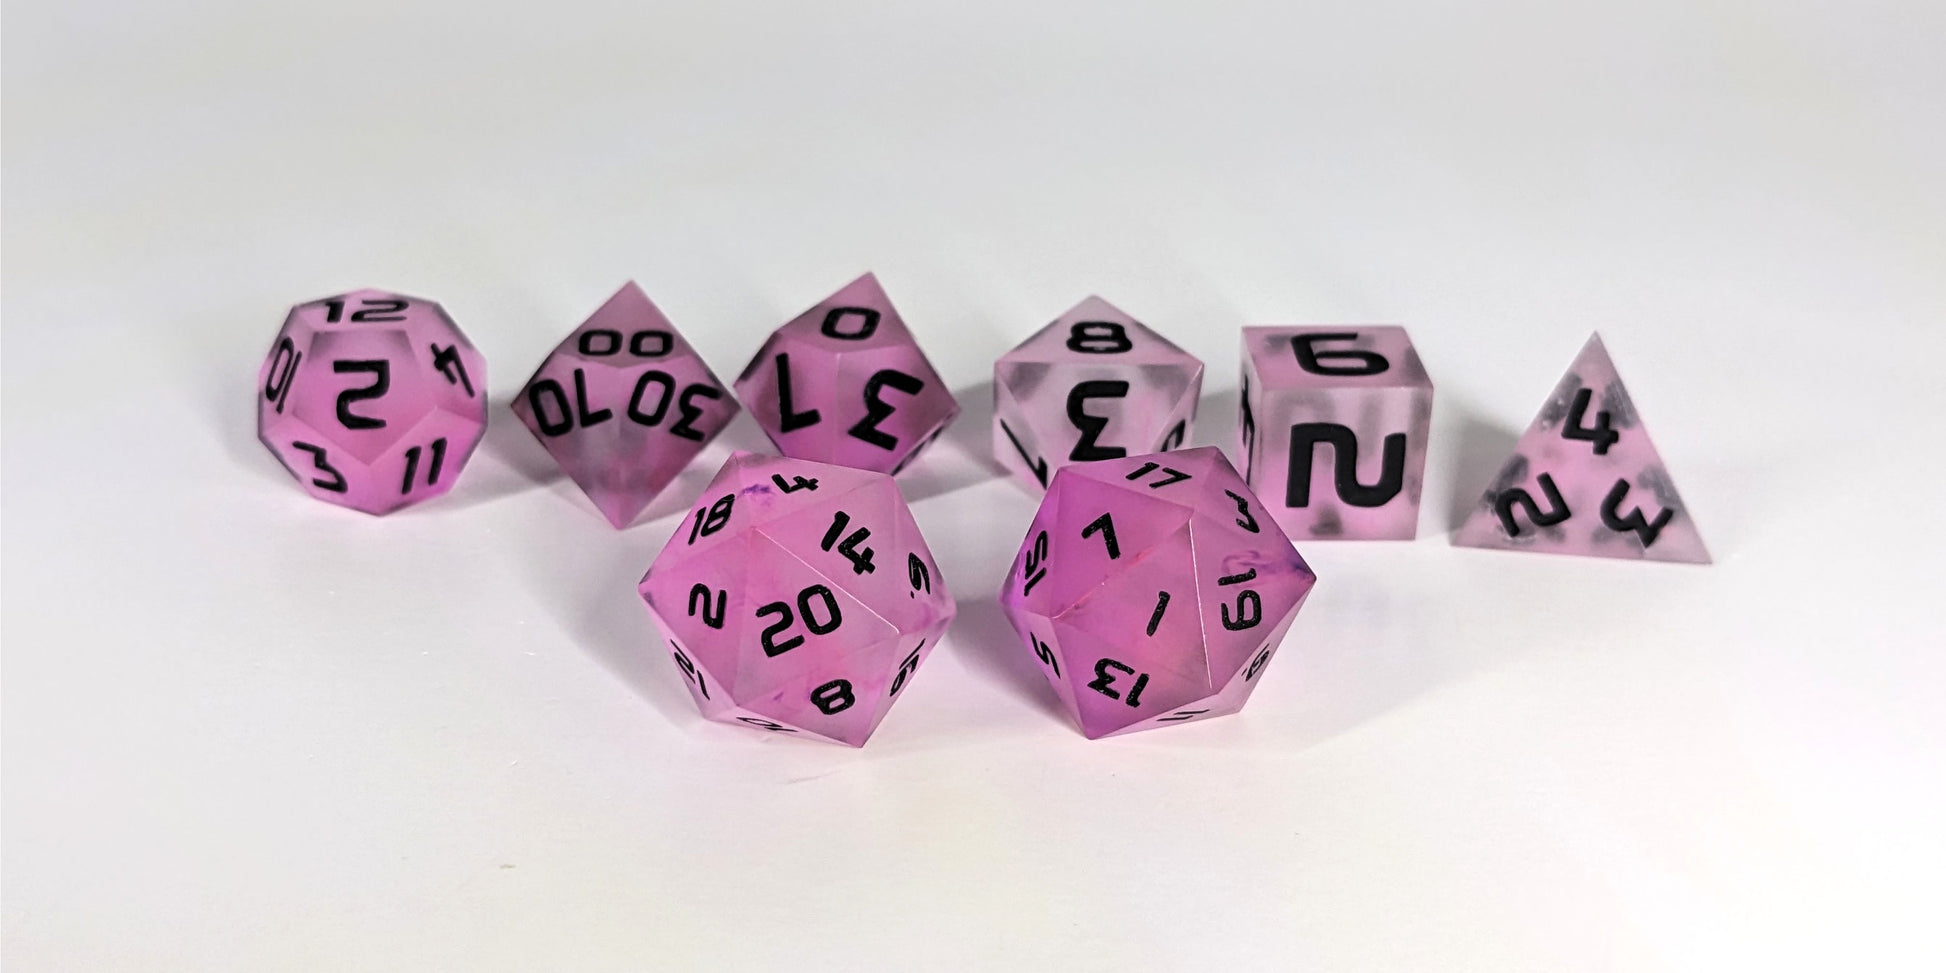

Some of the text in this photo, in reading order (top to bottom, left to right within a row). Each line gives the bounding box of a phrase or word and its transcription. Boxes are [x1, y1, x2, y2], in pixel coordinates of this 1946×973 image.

[325, 299, 409, 323] 12
[821, 307, 881, 340] 0
[1066, 321, 1132, 354] 8
[431, 343, 476, 398] 4
[578, 329, 674, 358] 00
[1290, 332, 1390, 376] 6
[265, 337, 302, 414] 10
[333, 359, 390, 430] 2
[528, 367, 613, 437] 70
[776, 352, 822, 434] 7
[627, 370, 723, 443] 30
[848, 369, 924, 451] 3
[1066, 380, 1129, 461] 3
[1561, 388, 1619, 455] 4
[293, 441, 348, 493] 3
[402, 437, 447, 495] 11
[772, 474, 819, 493] 4
[1125, 461, 1192, 489] 17
[1286, 422, 1406, 508] 2
[688, 493, 735, 546] 18
[1224, 489, 1260, 533] 3
[1492, 472, 1571, 537] 2
[1600, 478, 1673, 548] 3
[821, 511, 875, 574] 14
[1024, 530, 1048, 597] 15
[1081, 512, 1121, 559] 7
[688, 583, 727, 629] 2
[756, 584, 842, 658] 20
[1146, 591, 1170, 637] 1
[1218, 568, 1261, 631] 19
[810, 679, 855, 715] 8
[1087, 657, 1150, 708] 13
